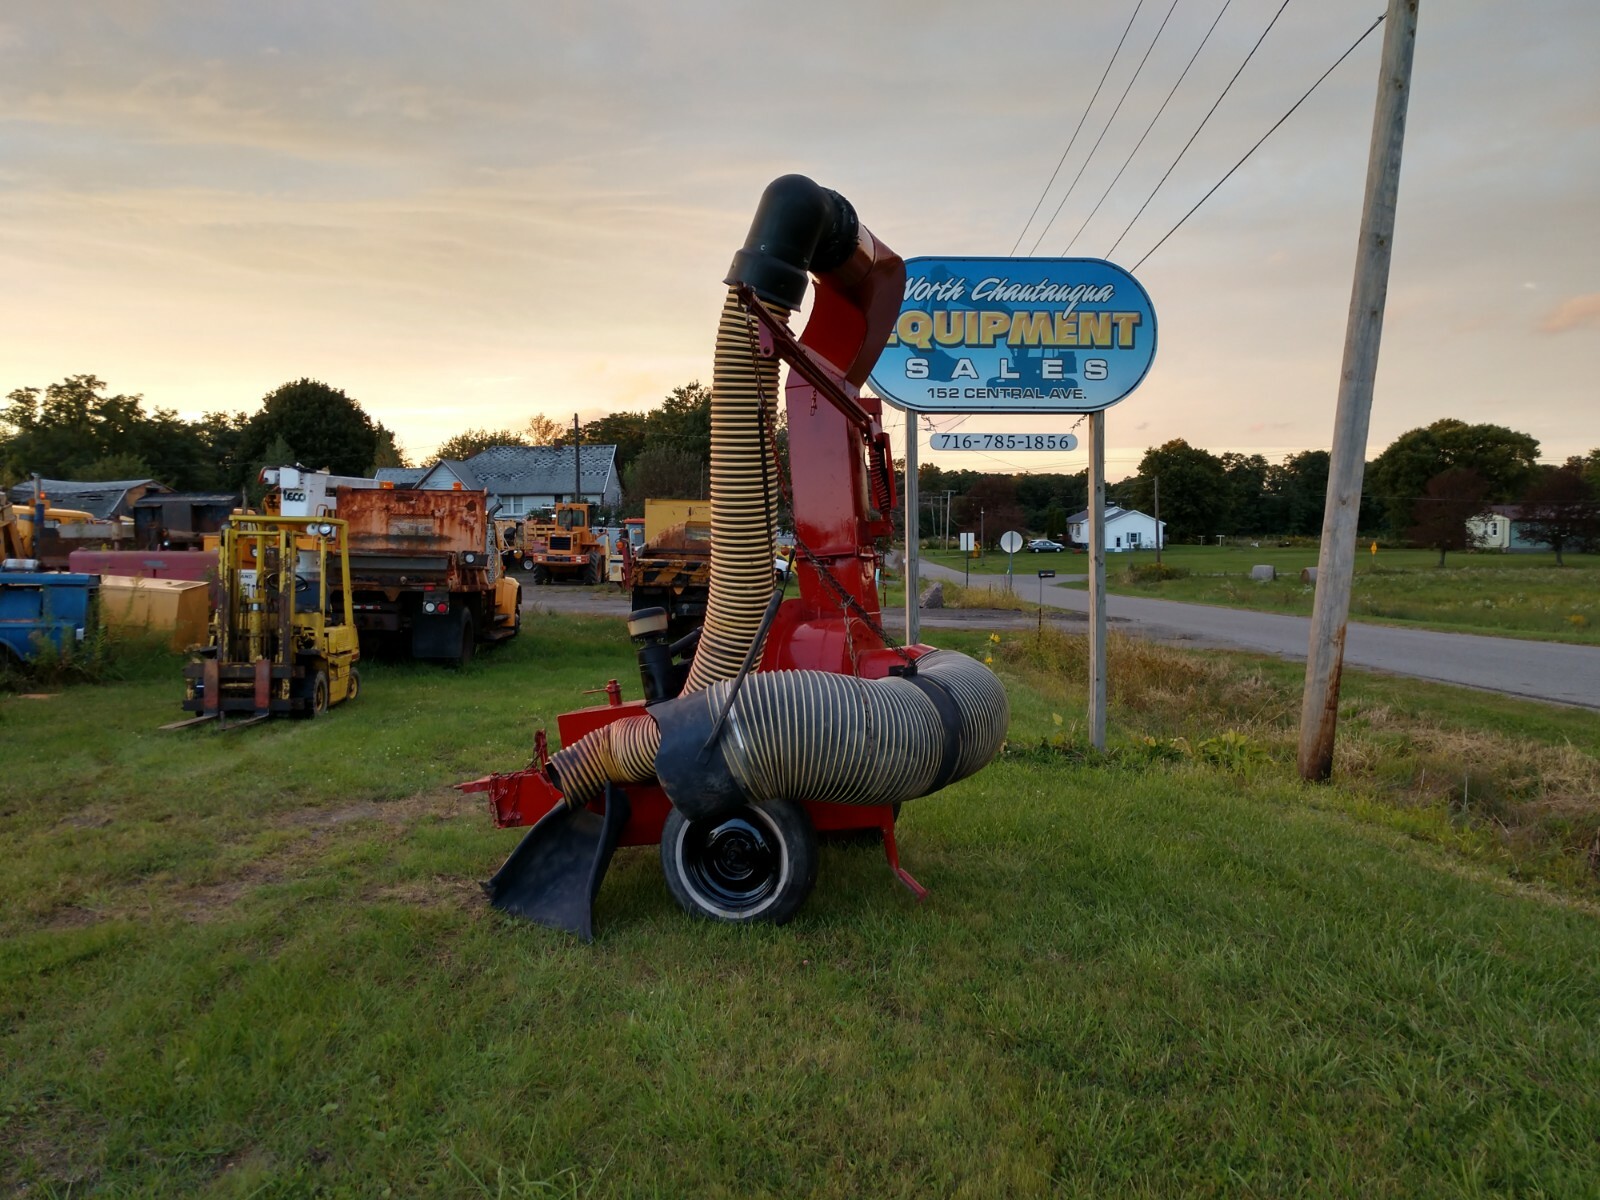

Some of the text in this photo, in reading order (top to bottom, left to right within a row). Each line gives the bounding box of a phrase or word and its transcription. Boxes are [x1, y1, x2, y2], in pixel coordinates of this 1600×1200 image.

[903, 276, 966, 302] North
[886, 310, 1140, 350] QUIPMENT
[927, 387, 1087, 400] 152 CENTRAL AVE.
[941, 433, 1070, 450] 716-785-1856
